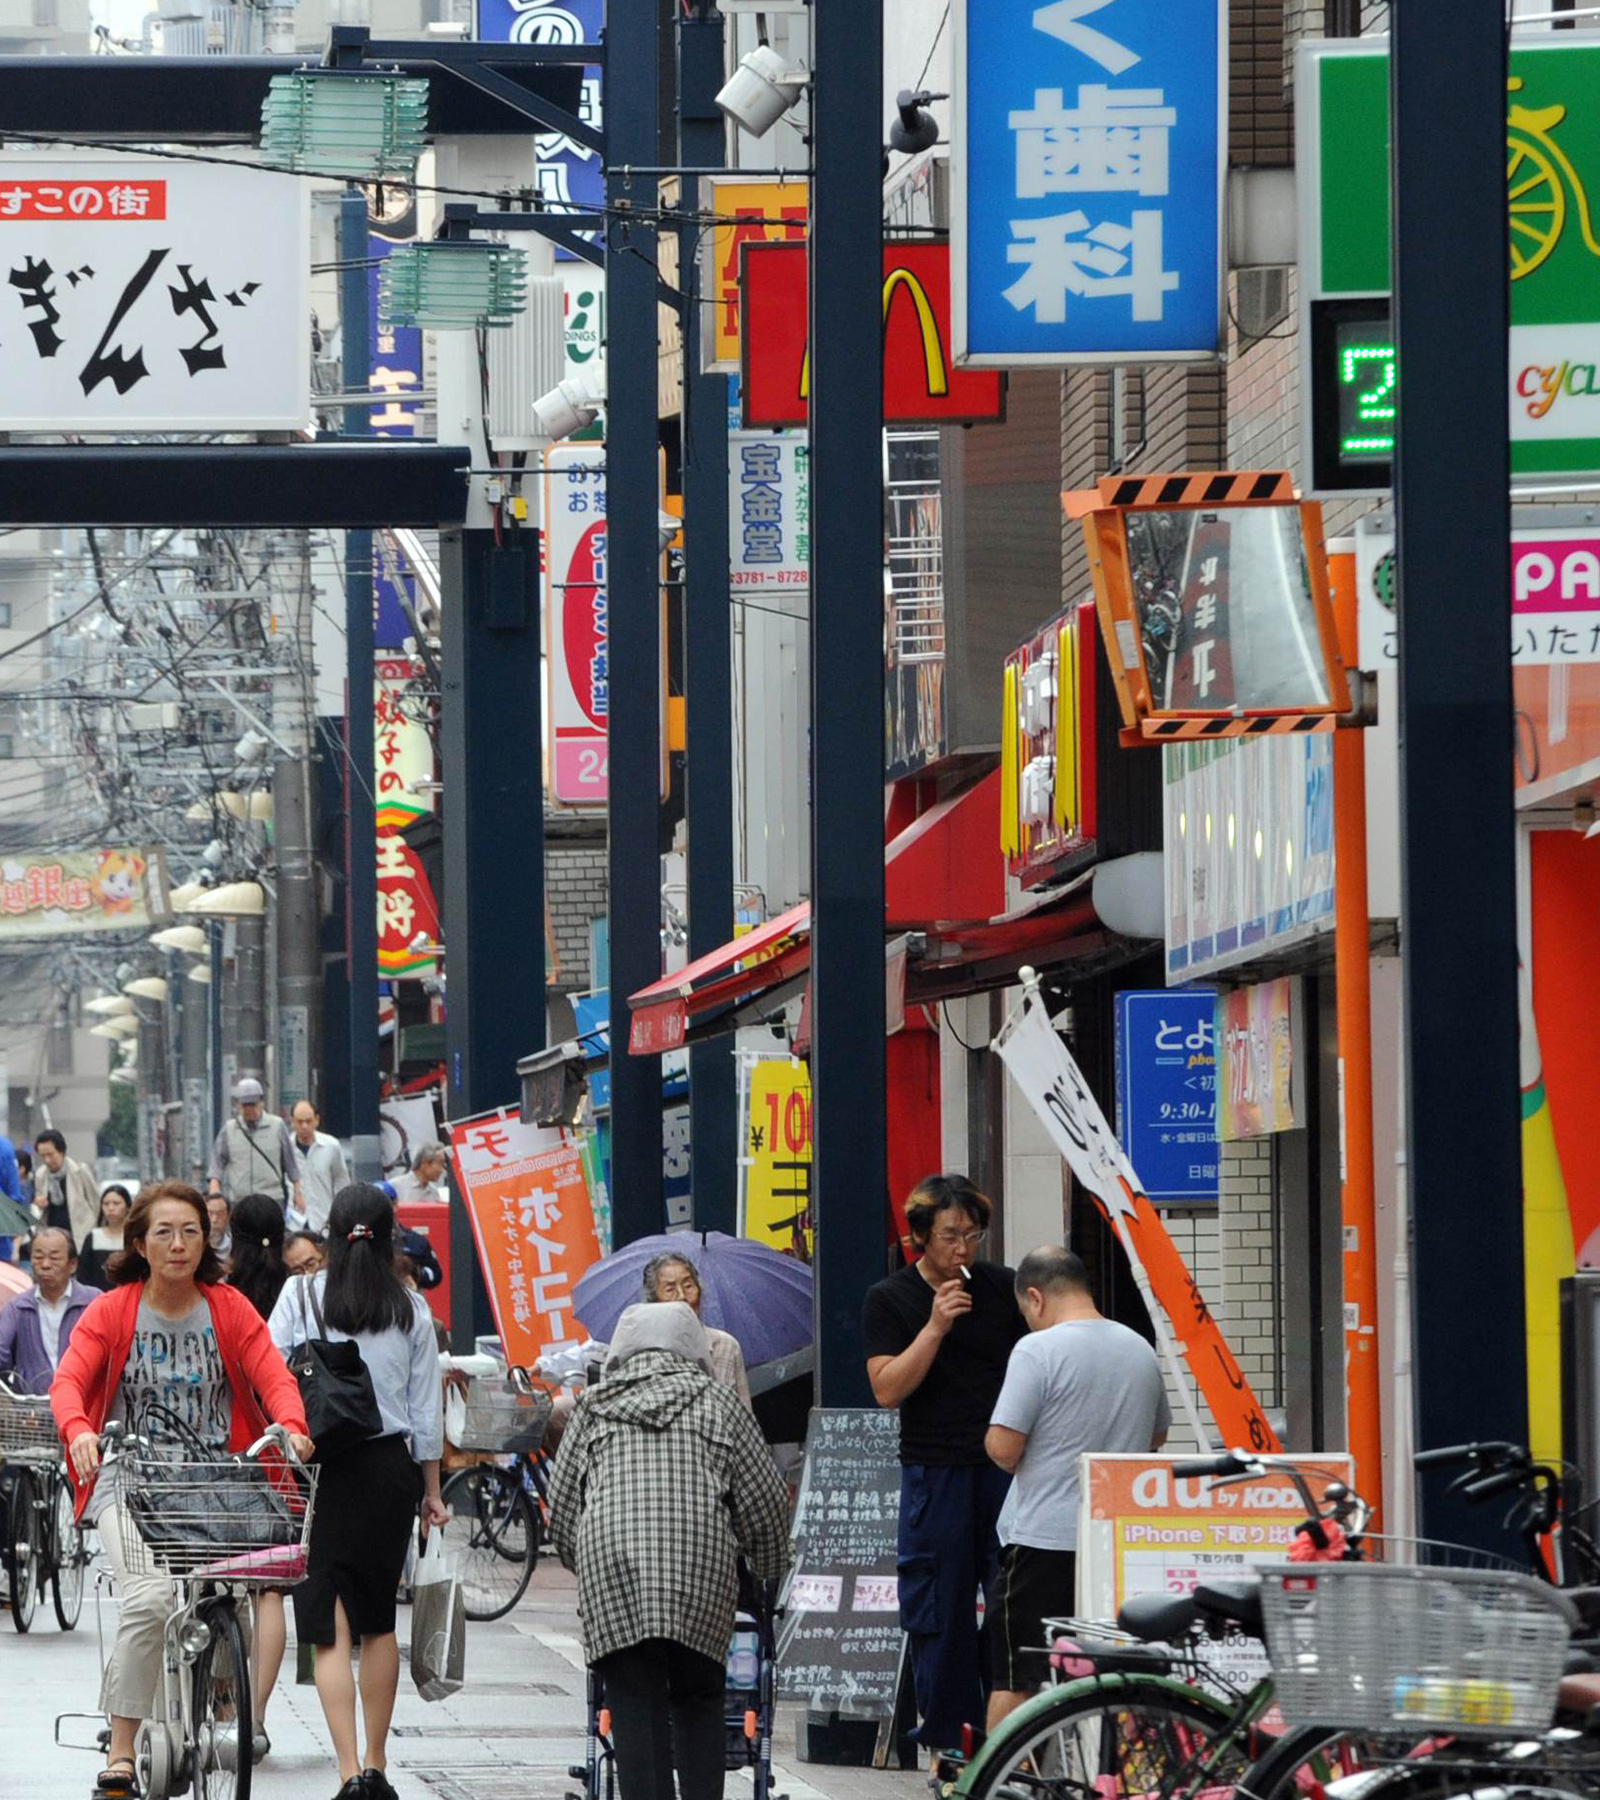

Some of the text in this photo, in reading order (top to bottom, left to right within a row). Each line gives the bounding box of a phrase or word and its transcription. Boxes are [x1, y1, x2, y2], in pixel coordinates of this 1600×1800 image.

[741, 444, 783, 564] 宝金堂
[1159, 1102, 1215, 1120] 9:30-1
[1131, 1467, 1212, 1508] au
[1216, 1490, 1239, 1507] by
[1124, 1524, 1204, 1544] iPhone
